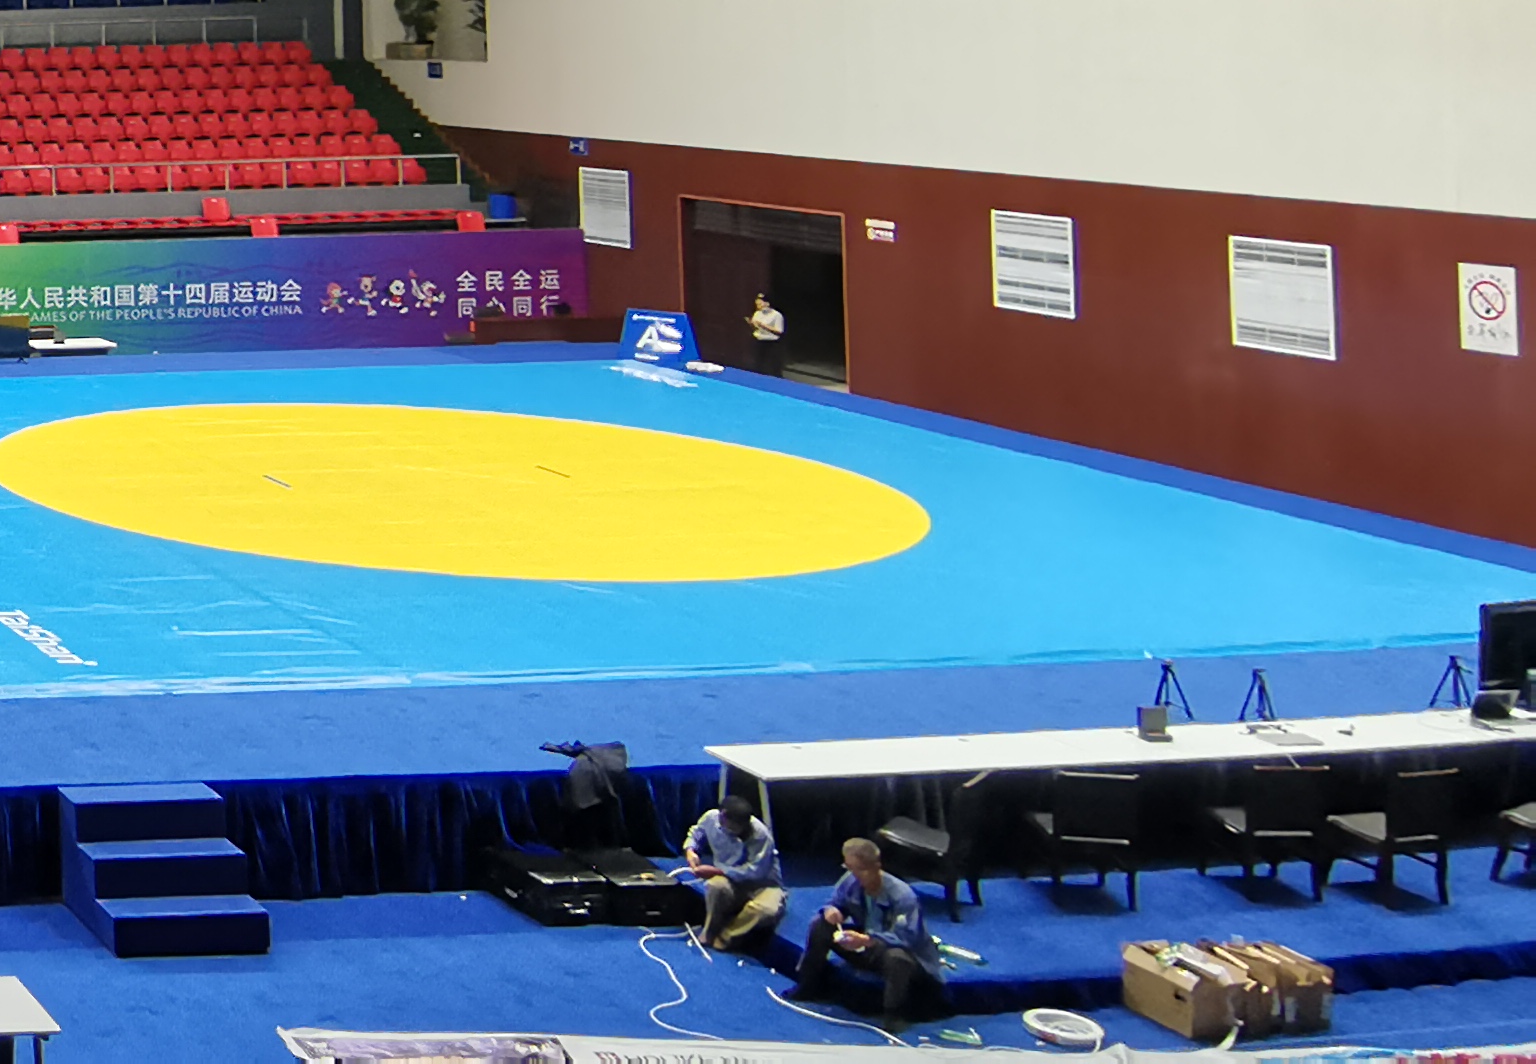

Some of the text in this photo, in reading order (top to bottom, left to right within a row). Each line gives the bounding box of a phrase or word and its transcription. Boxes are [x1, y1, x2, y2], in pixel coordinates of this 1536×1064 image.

[456, 269, 560, 292] 全民全运
[69, 310, 86, 322] OF
[89, 309, 112, 321] THE
[116, 307, 176, 320] PEOPLE'S
[178, 305, 243, 319] REPUBLIC
[242, 305, 259, 317] OF
[261, 304, 303, 317] CHINA
